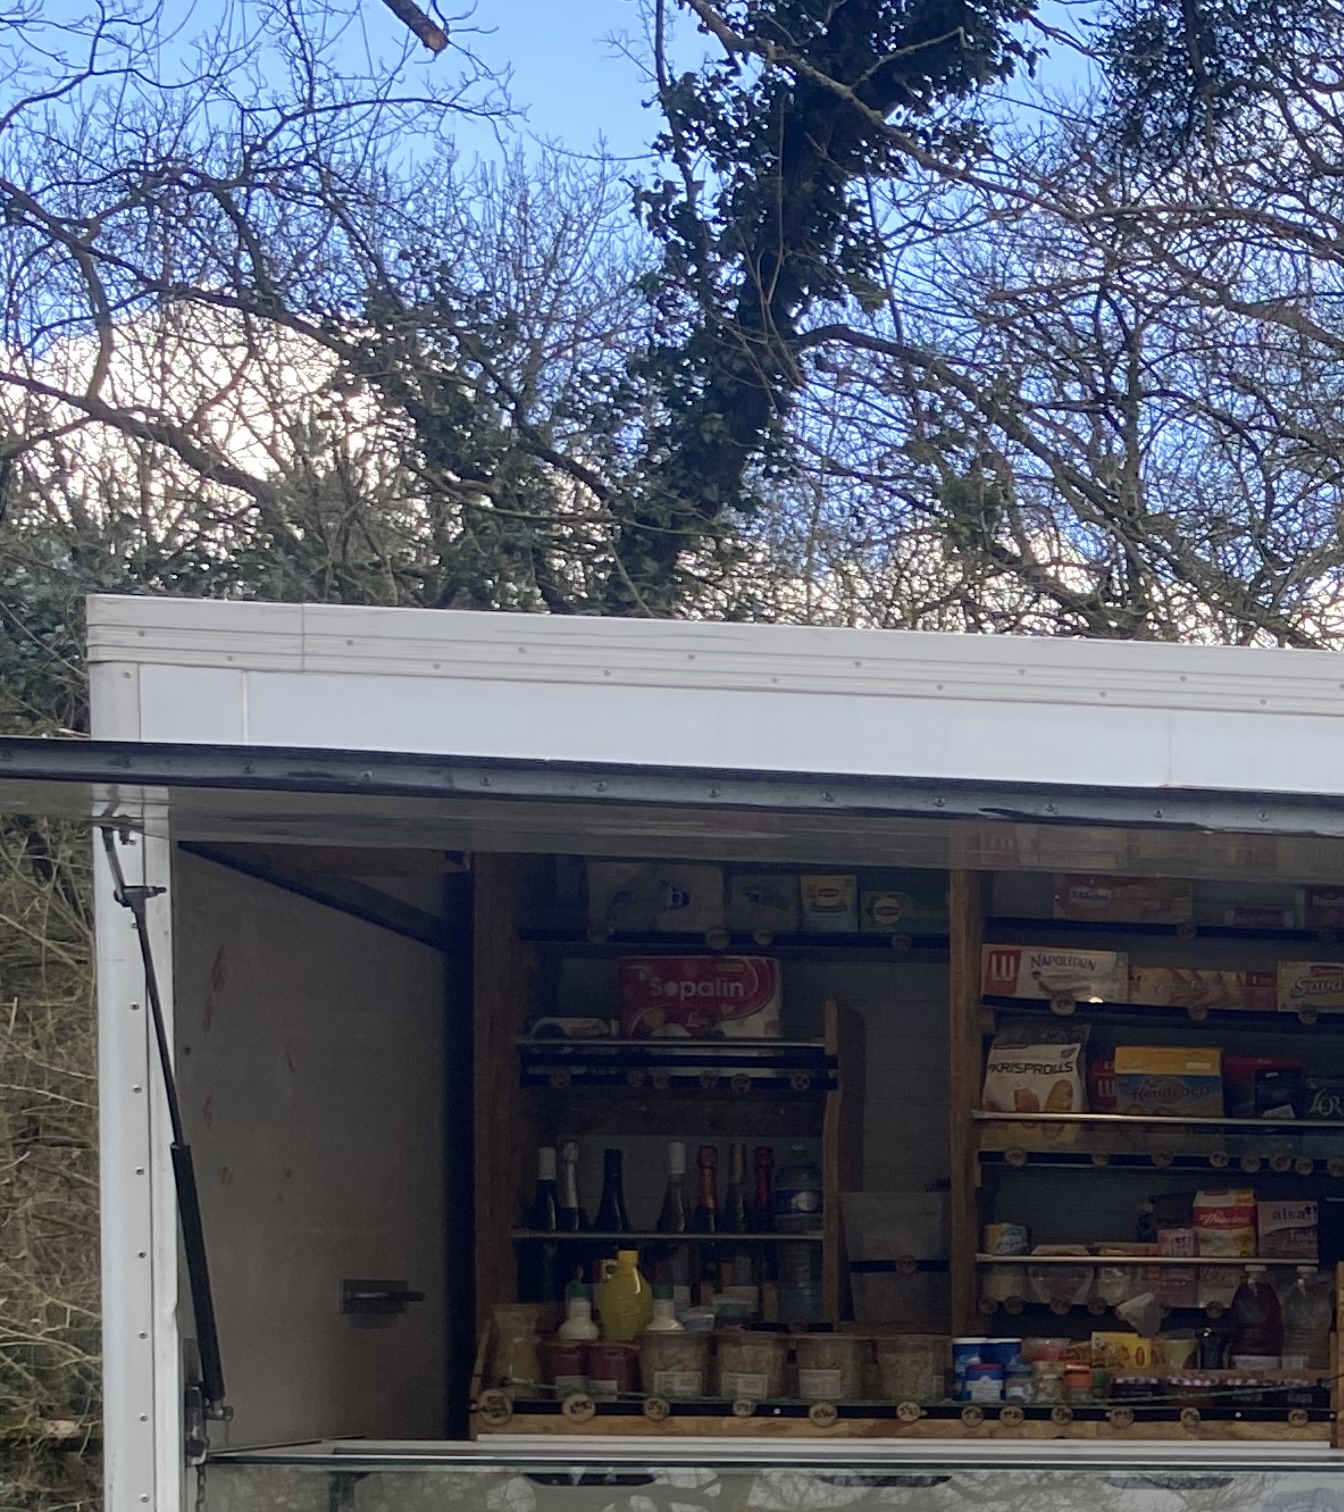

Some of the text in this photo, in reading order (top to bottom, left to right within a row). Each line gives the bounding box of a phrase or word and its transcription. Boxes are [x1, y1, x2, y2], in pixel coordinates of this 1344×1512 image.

[991, 953, 1016, 982] LU
[650, 976, 745, 1002] Sopalin
[1272, 1207, 1306, 1221] alsa
